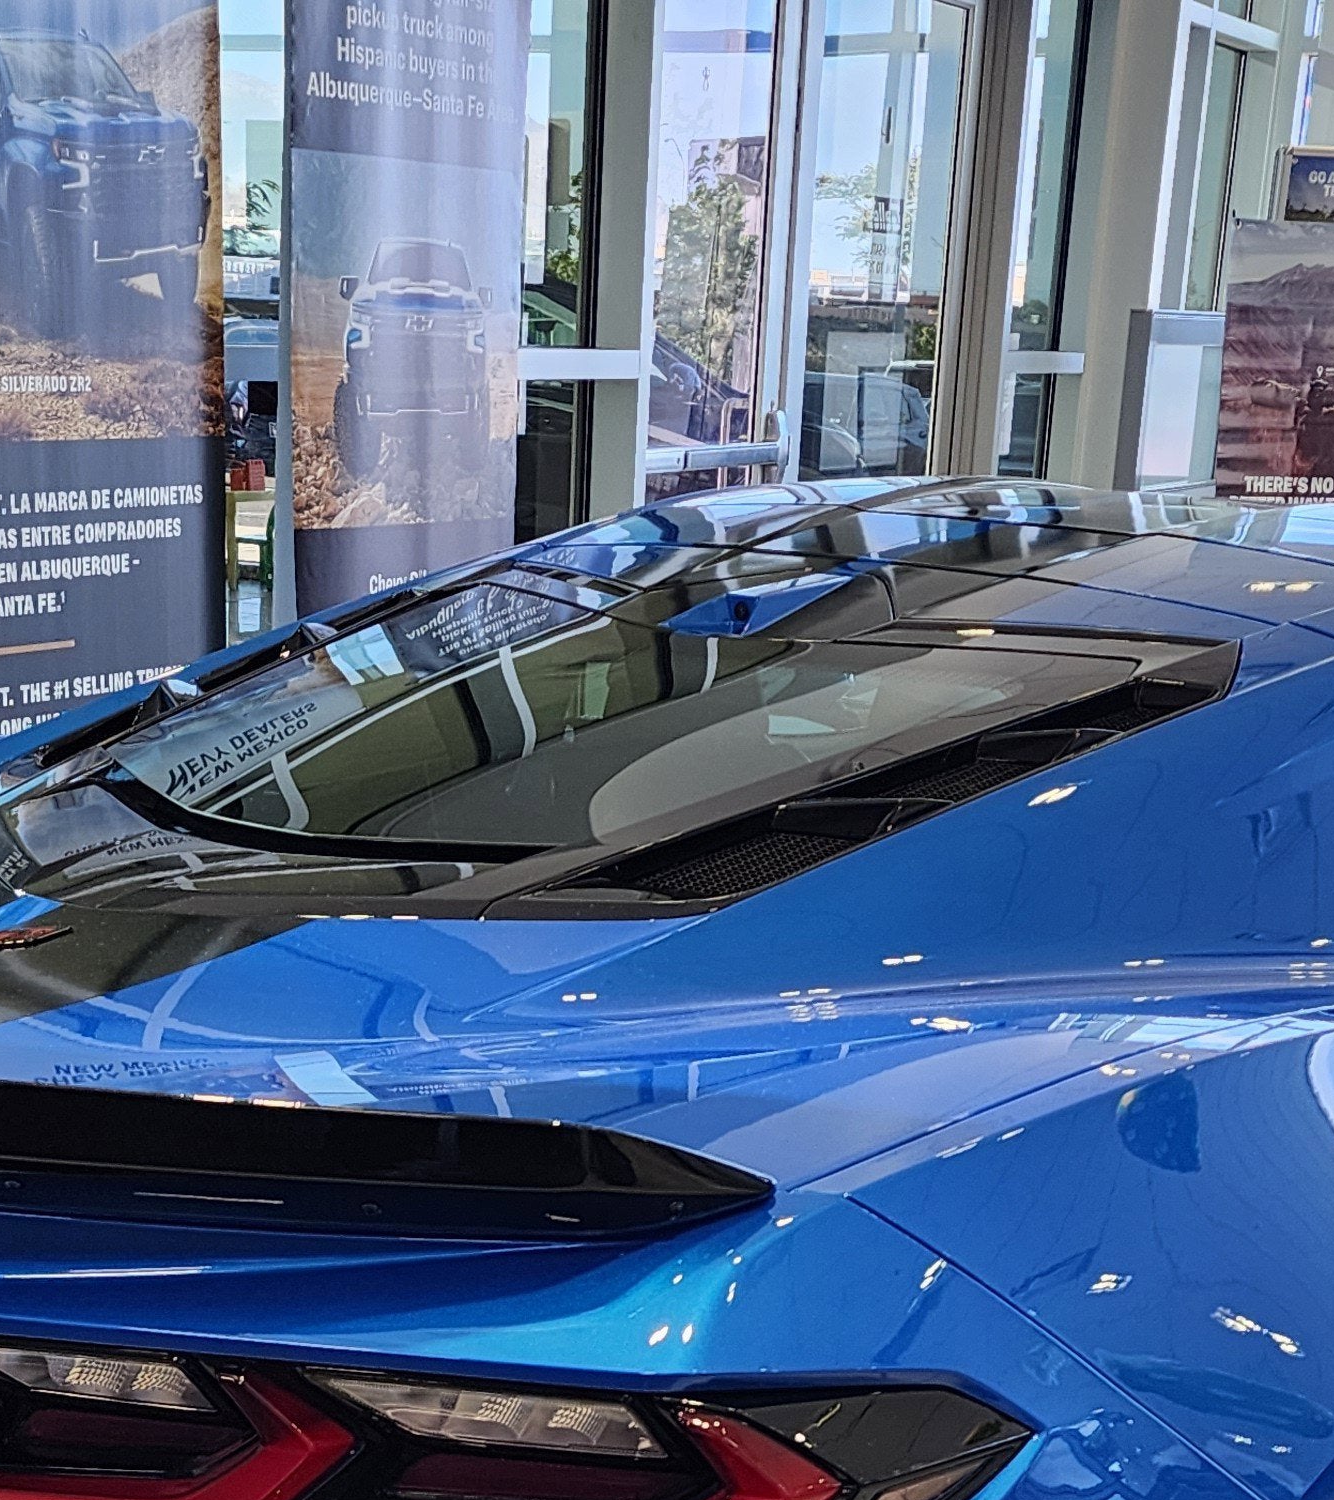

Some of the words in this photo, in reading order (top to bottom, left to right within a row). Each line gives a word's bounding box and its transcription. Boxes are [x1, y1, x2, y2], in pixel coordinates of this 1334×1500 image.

[403, 12, 444, 40] truck
[337, 37, 406, 70] Hispanic
[410, 48, 458, 80] buyers
[462, 57, 475, 82] in
[468, 95, 485, 118] Fe
[1309, 170, 1326, 184] GO
[1, 374, 67, 392] SILVERADO
[69, 374, 92, 392] ZR2
[1244, 475, 1308, 493] THERE'S
[1311, 476, 1334, 494] NO
[10, 491, 31, 515] LA
[34, 489, 88, 513] MARCA
[91, 488, 111, 510] DE
[113, 484, 204, 509] CAMIONETAS
[21, 525, 72, 549] ENTRE
[74, 517, 182, 546] COMPRADORES
[20, 553, 130, 582] ALBUQUERQUE
[19, 681, 51, 705] THE
[53, 678, 70, 700] #1
[73, 670, 134, 697] SELLING
